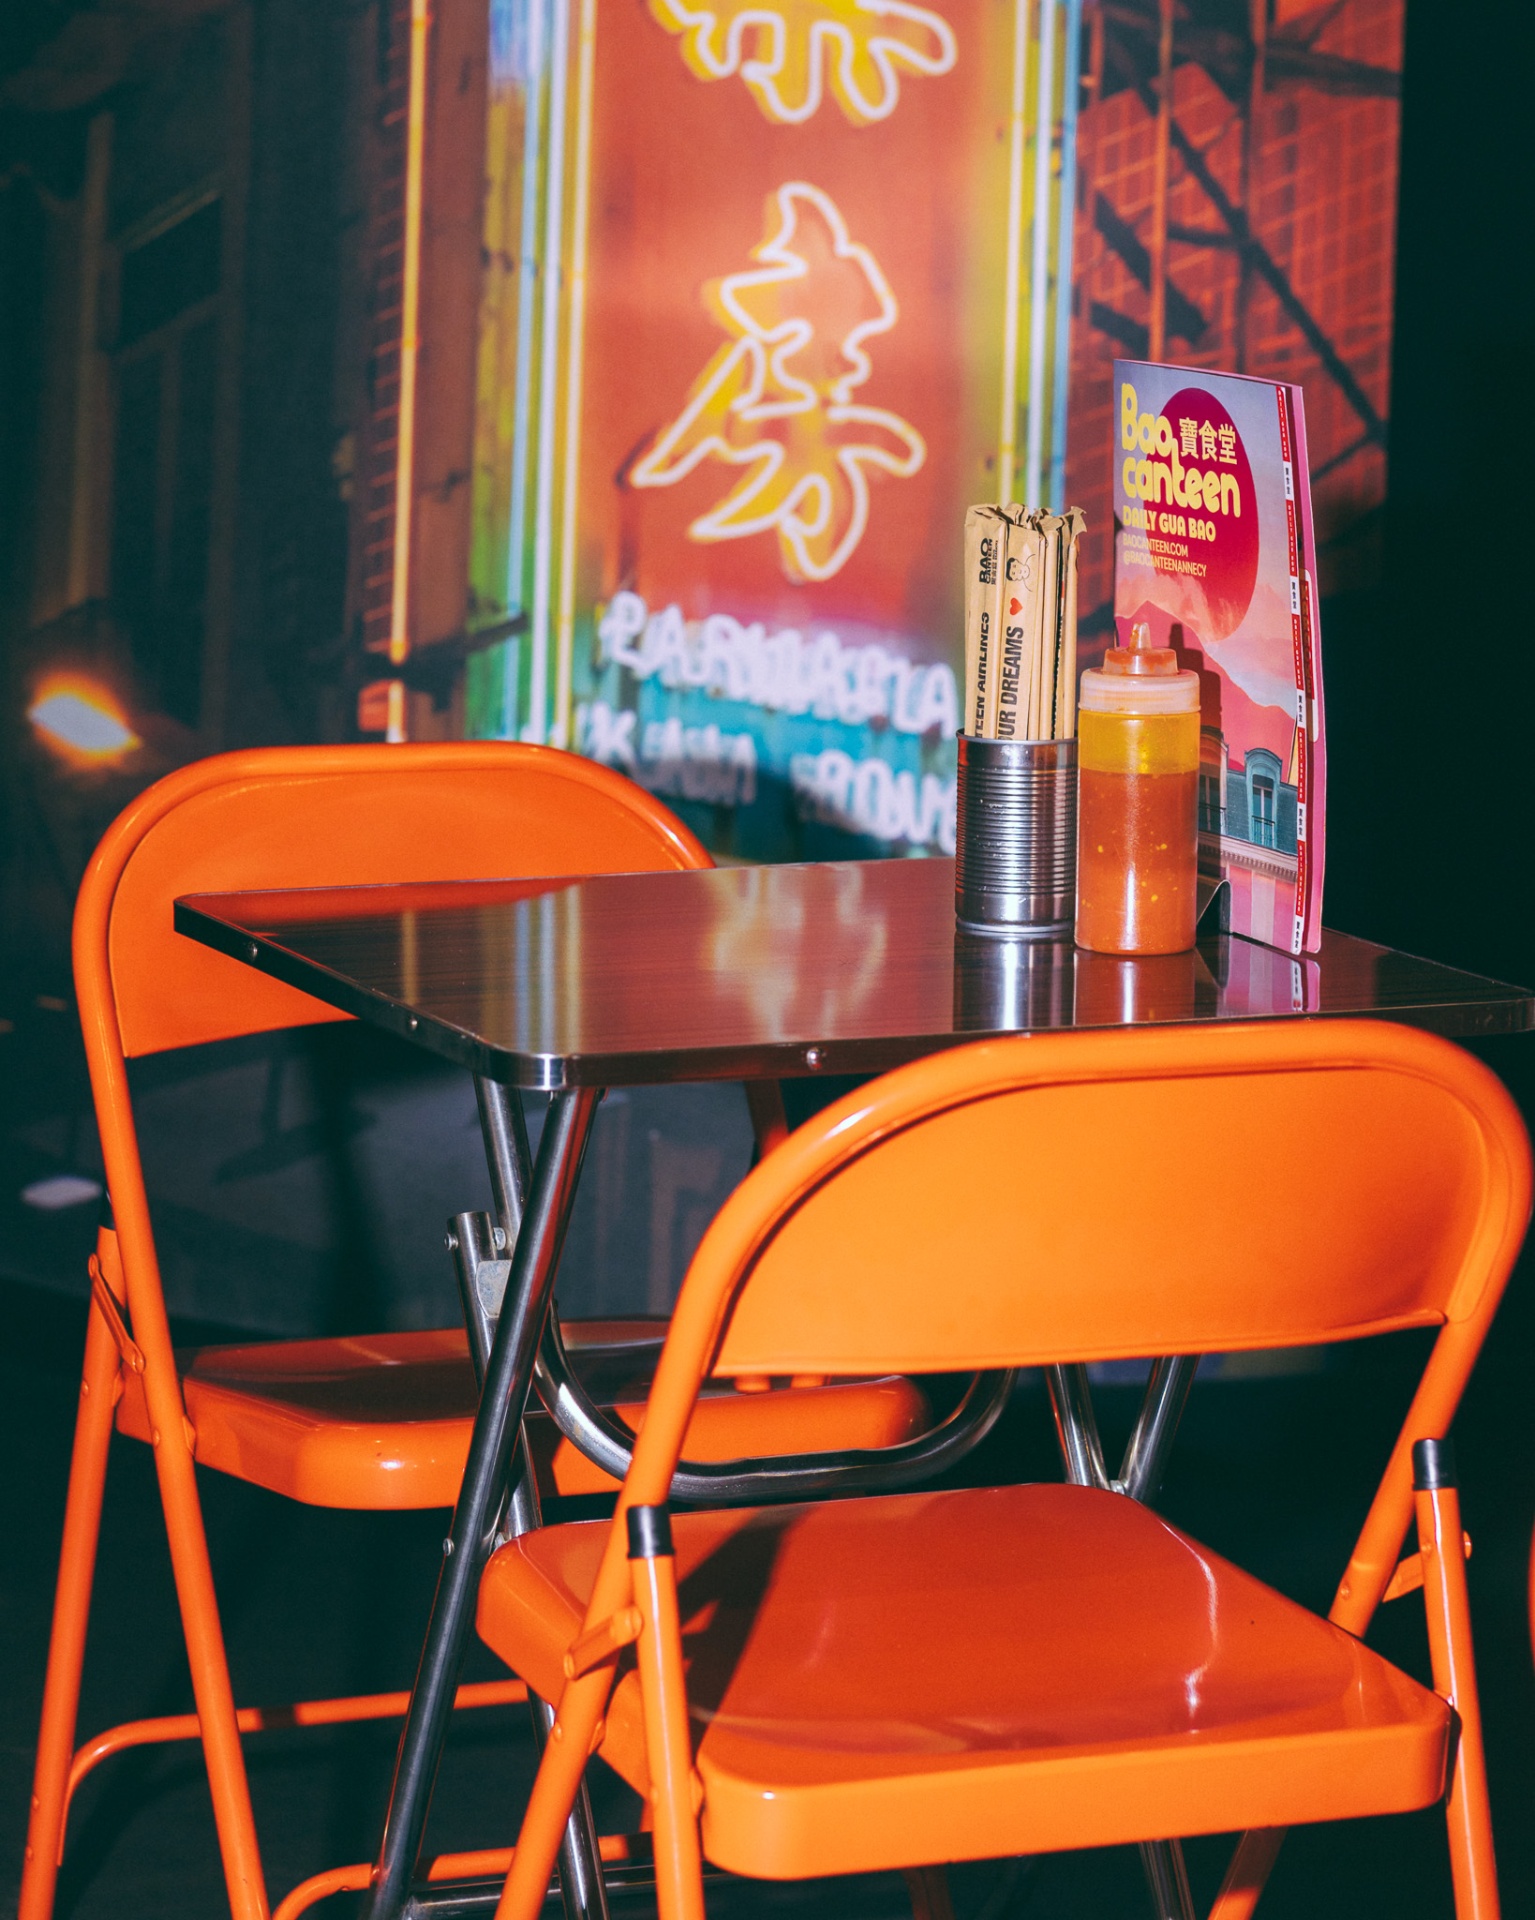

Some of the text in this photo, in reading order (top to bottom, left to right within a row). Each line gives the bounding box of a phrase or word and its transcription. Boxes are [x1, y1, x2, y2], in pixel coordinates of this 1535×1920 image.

[1121, 383, 1173, 457] Bao
[1178, 417, 1237, 465] 寶食堂
[1122, 438, 1241, 518] canteen
[1122, 505, 1216, 542] DAILY GUA BAO
[1122, 533, 1188, 557] BAOCANTEEN.COM
[979, 538, 988, 583] BAO
[1123, 550, 1207, 577] @BAOCANTEENANNECY
[977, 612, 989, 693] AIRLINES
[1001, 626, 1023, 705] DREAMS
